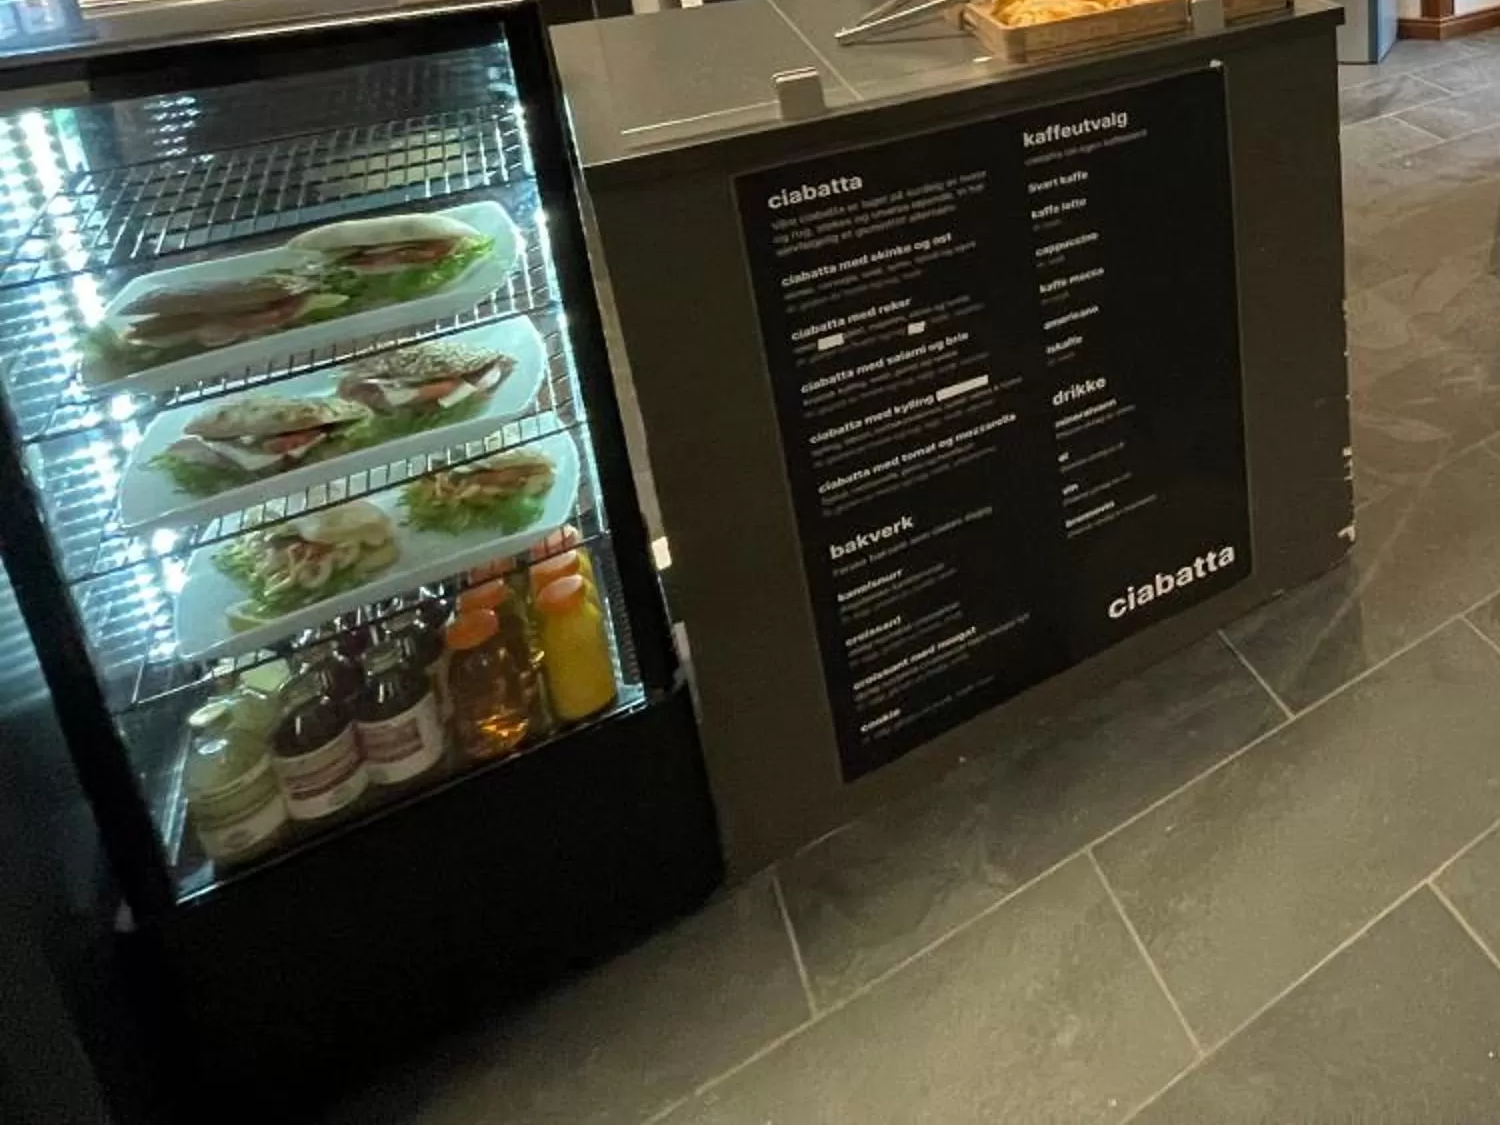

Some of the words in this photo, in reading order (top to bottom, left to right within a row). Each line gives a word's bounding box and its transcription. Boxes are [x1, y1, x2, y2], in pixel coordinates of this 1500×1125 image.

[1023, 110, 1128, 148] kaffeutvalg
[768, 175, 863, 209] ciabatta
[781, 264, 837, 287] ciabatta
[791, 318, 846, 342] ciabatta
[800, 369, 855, 394] ciabatta
[1052, 376, 1106, 406] drikke
[809, 419, 863, 444] ciabatta
[829, 515, 914, 560] bakverk
[1108, 544, 1236, 620] ciabatta
